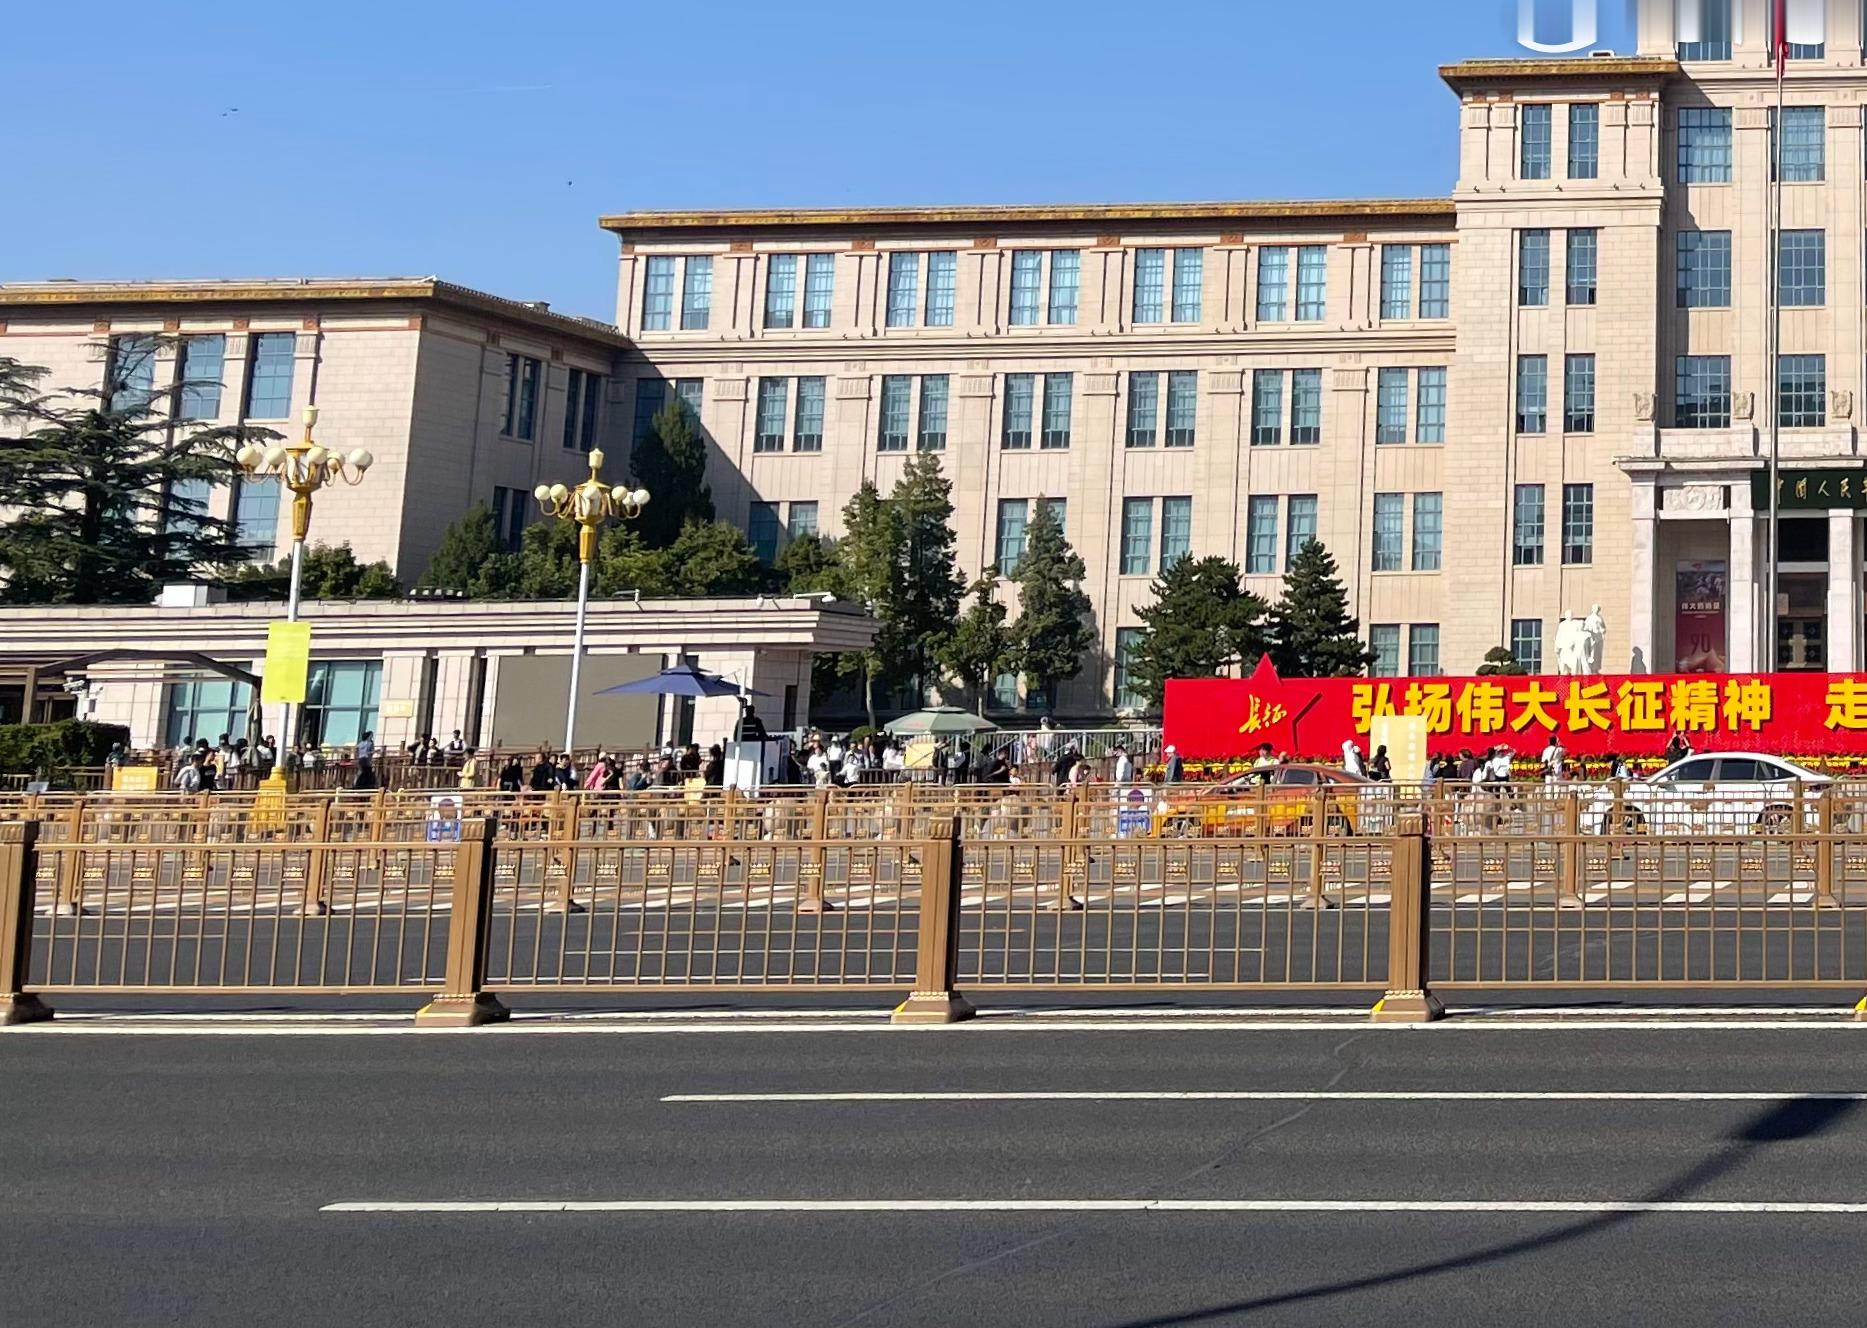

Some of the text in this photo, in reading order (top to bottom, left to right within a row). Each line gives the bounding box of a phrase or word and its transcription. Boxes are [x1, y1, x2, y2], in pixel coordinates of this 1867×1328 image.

[1352, 680, 1771, 733] 弘扬伟大长征精神
